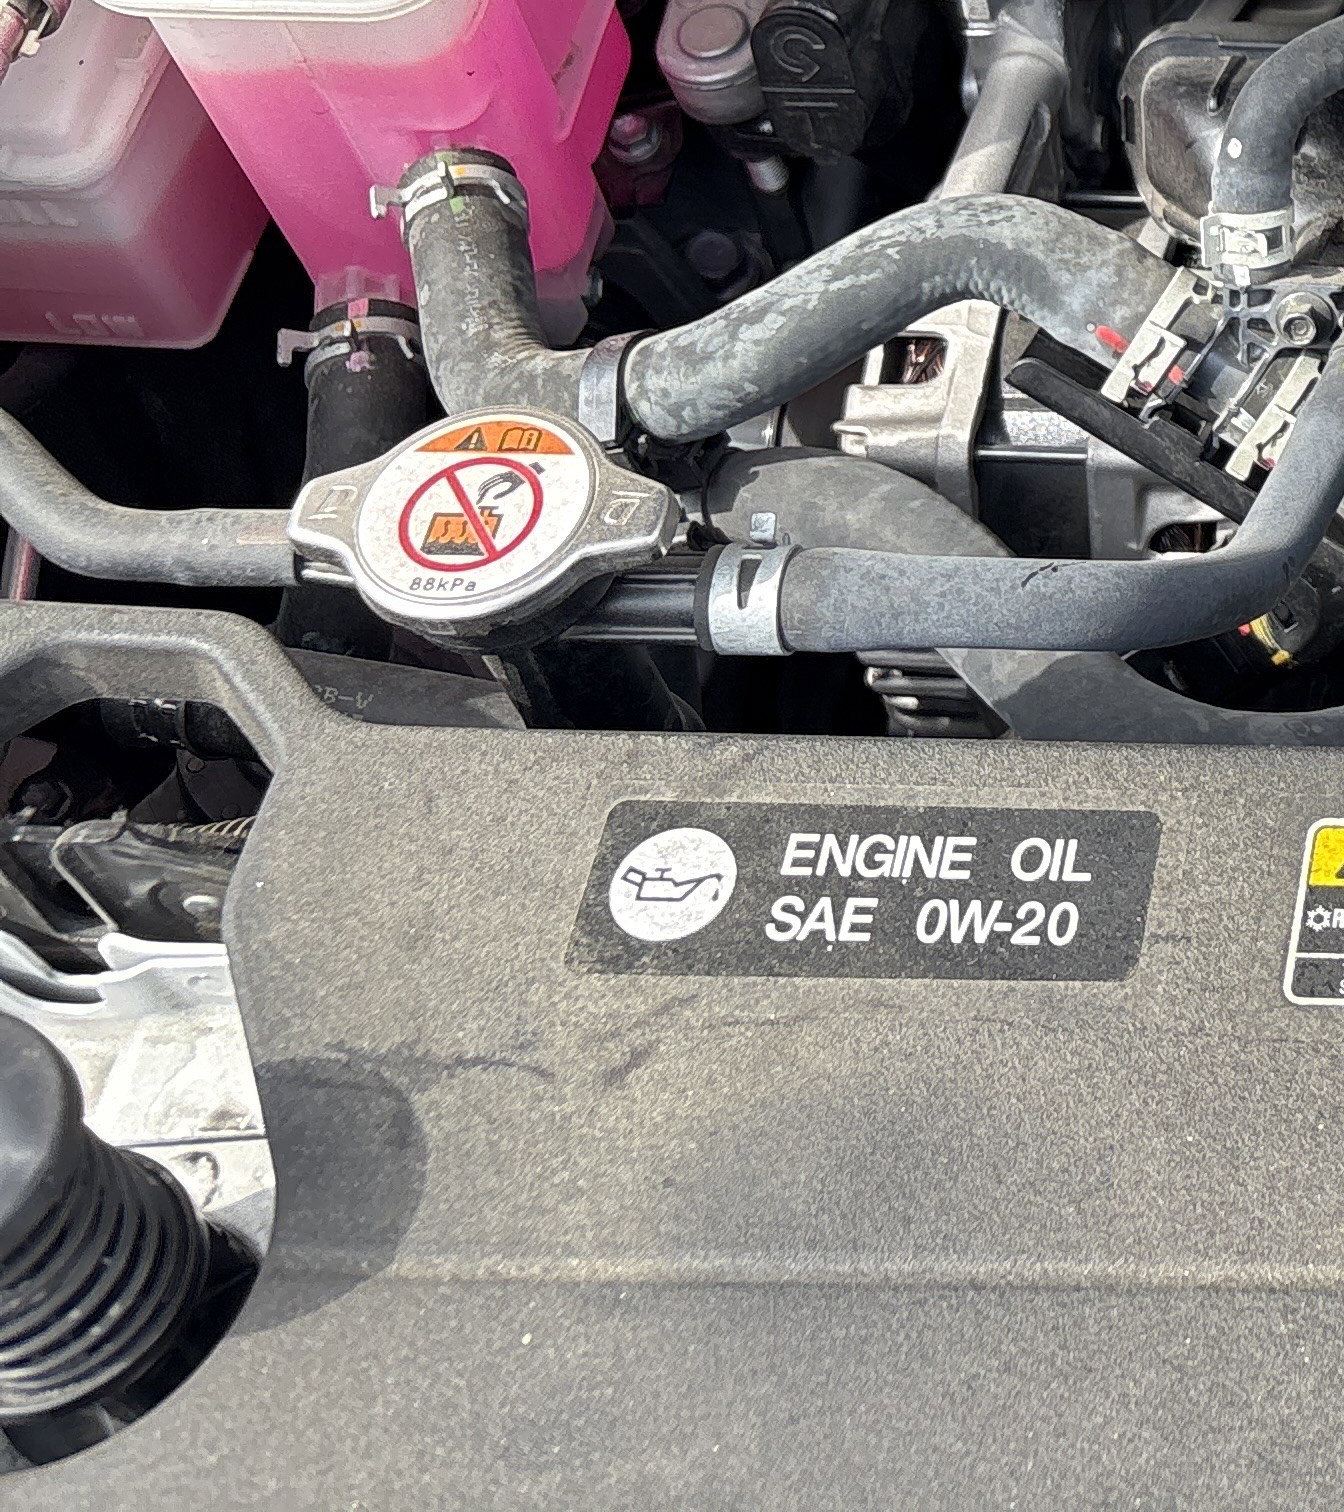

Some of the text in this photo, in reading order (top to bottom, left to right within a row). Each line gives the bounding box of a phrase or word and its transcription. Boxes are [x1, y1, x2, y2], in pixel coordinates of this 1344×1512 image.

[409, 575, 478, 591] 88kPa
[779, 832, 1093, 883] ENGINE OIL
[765, 894, 1080, 946] SAE 0W-20
